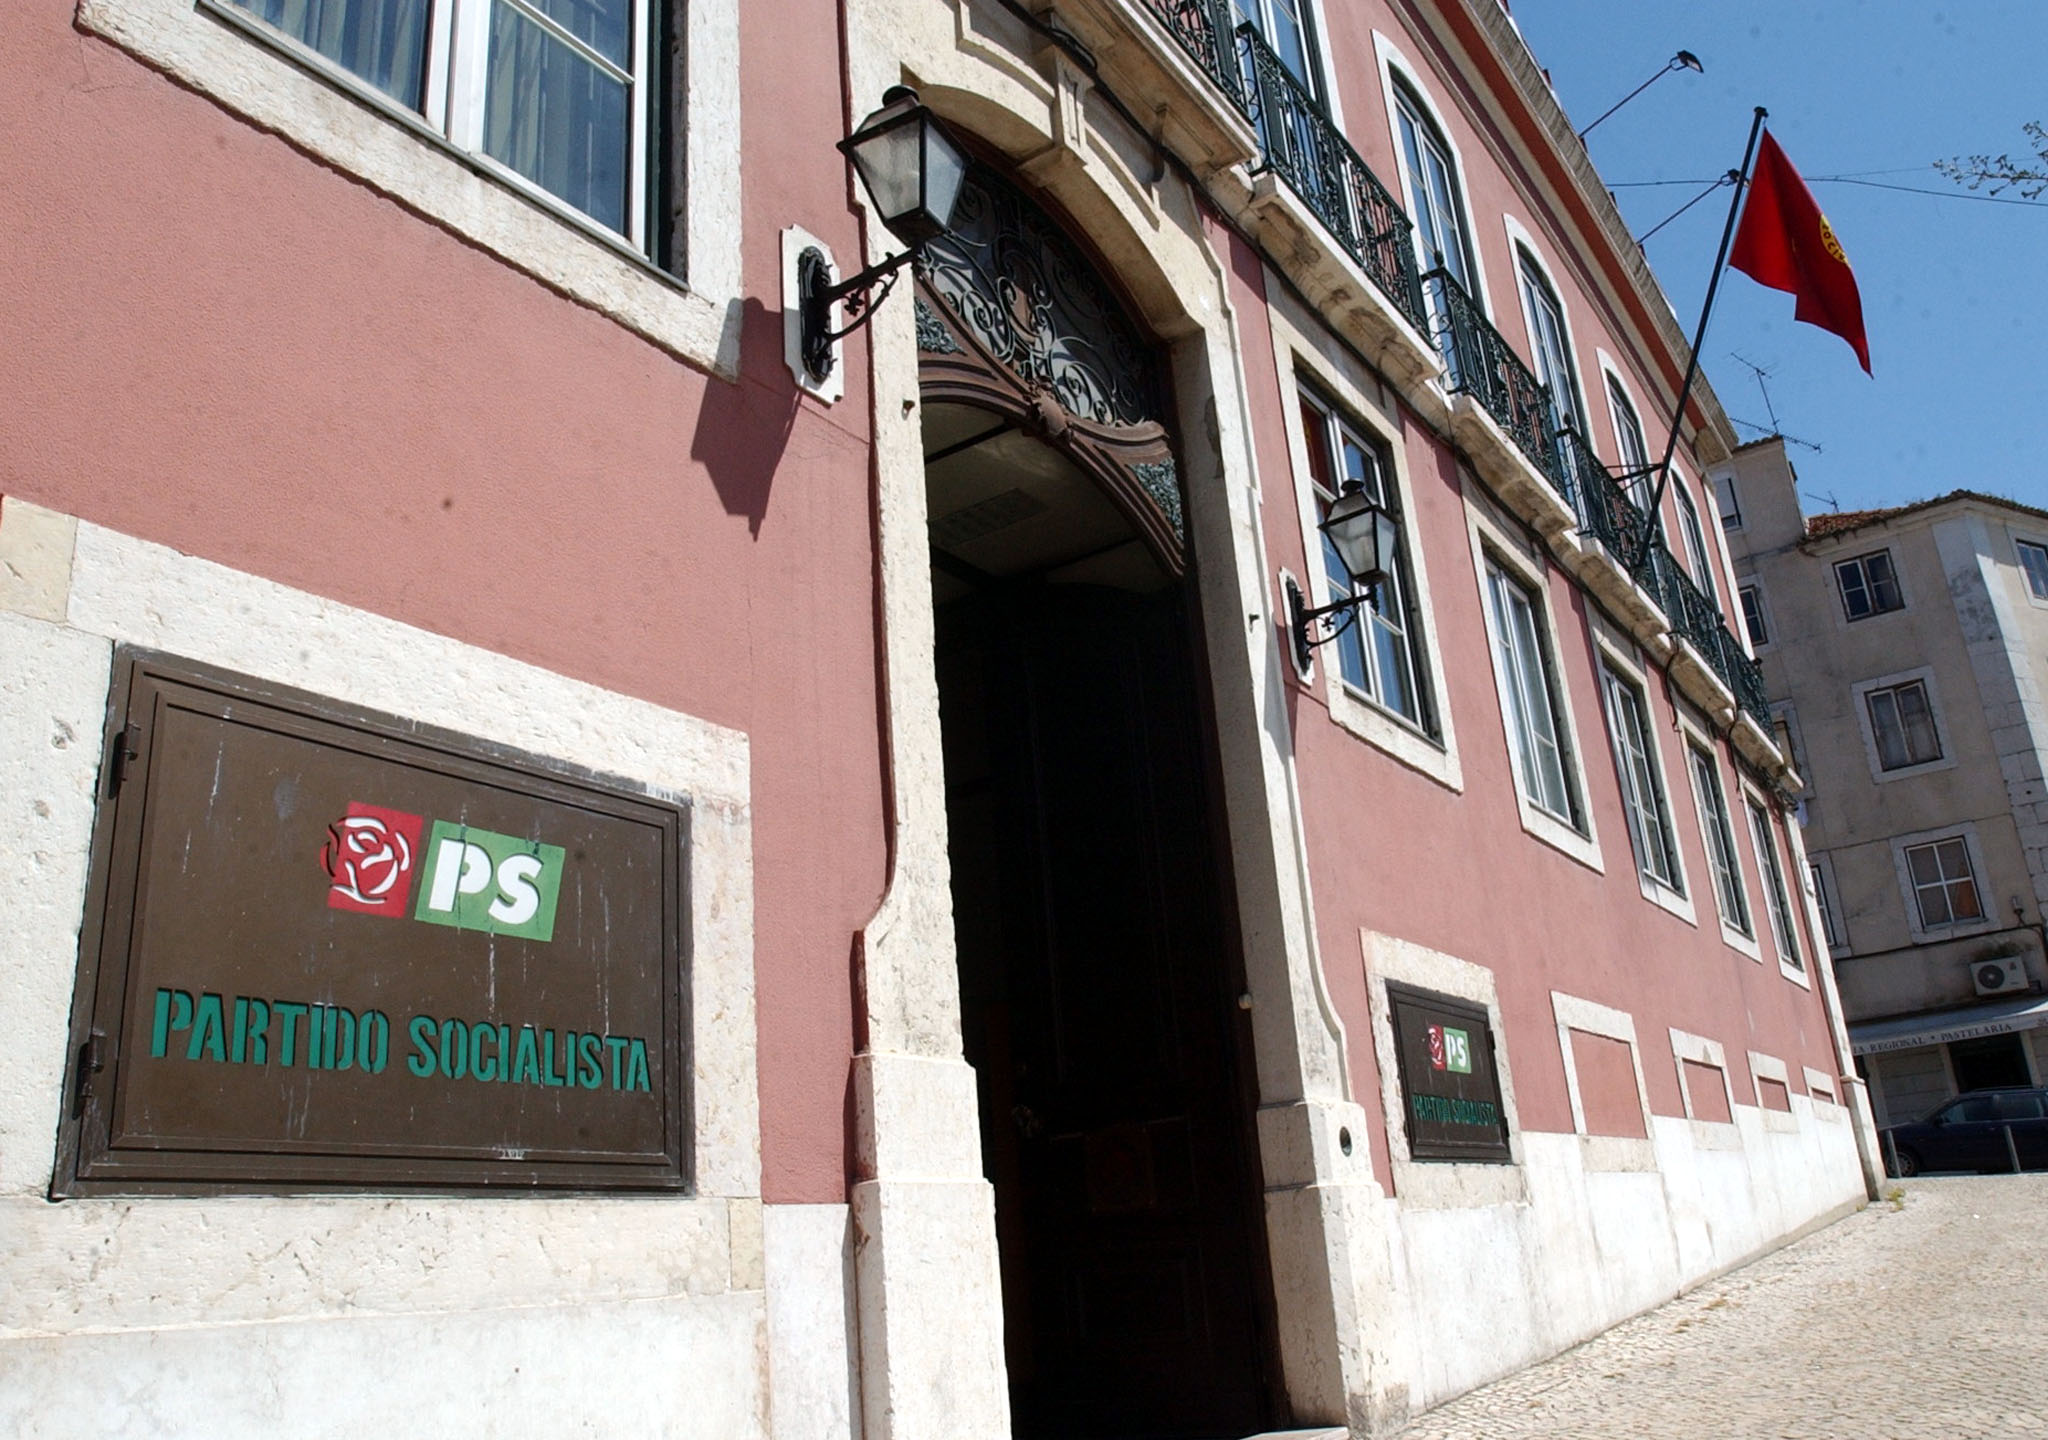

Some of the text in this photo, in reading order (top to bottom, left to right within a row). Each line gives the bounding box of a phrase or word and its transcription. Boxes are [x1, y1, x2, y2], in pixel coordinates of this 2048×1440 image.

[428, 838, 544, 925] PS
[151, 988, 652, 1092] PARTIDO SOCIALISTA
[1445, 1033, 1467, 1068] PS
[1869, 1036, 1926, 1052] REGIONAL
[1941, 1023, 2013, 1041] PASTELARIA
